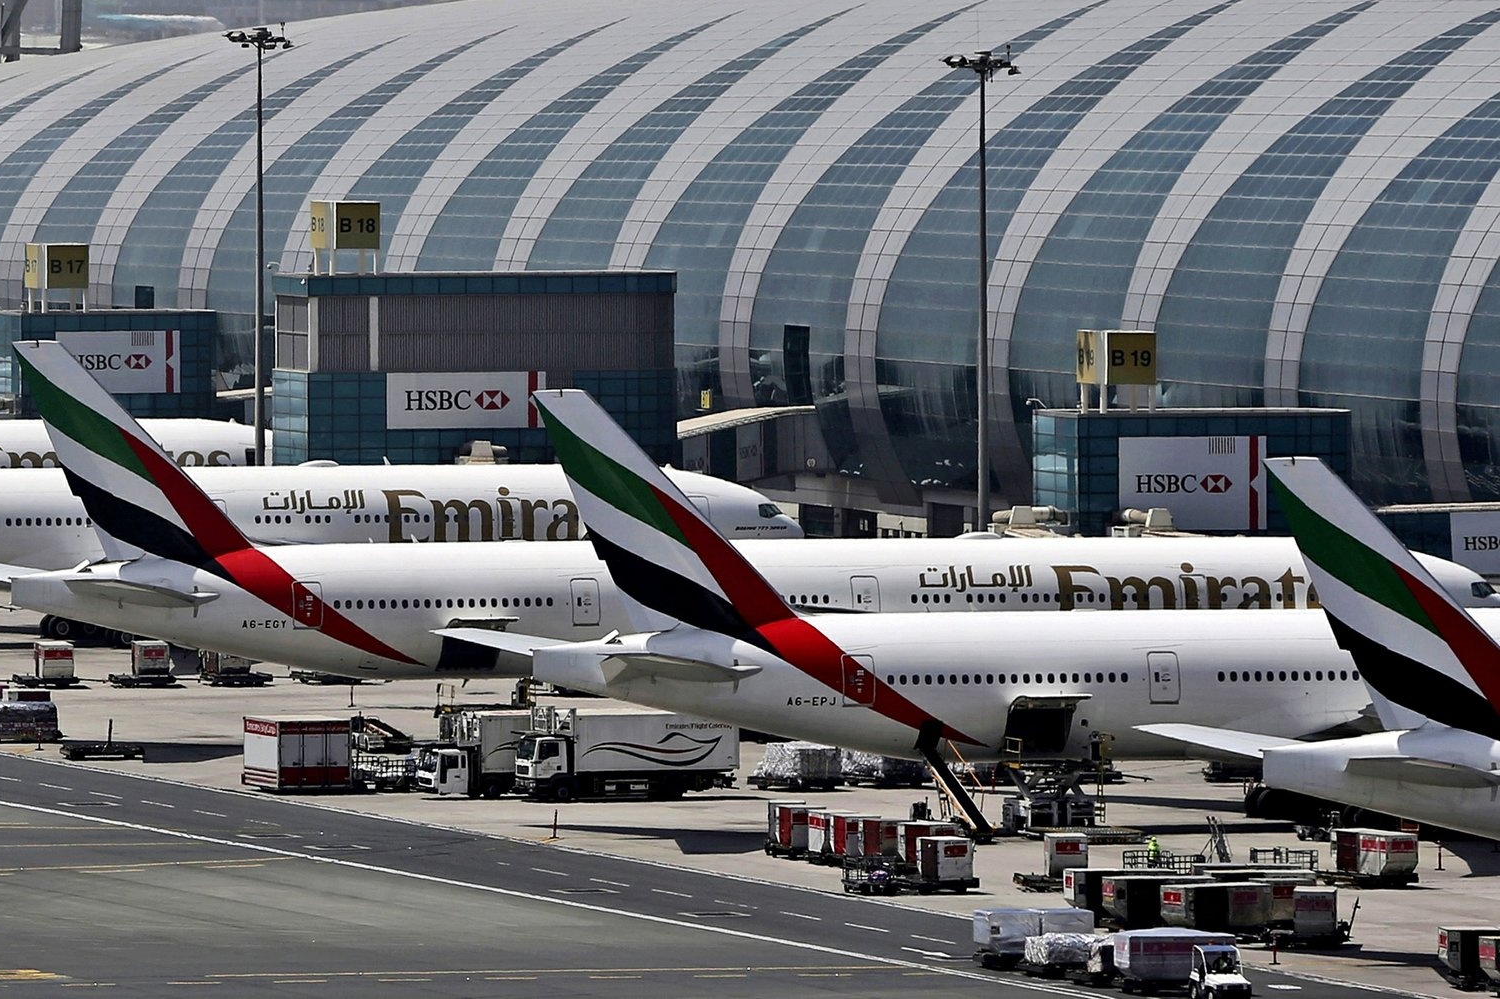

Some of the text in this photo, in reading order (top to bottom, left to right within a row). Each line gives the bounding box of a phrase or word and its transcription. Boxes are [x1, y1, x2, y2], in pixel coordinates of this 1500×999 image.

[340, 218, 376, 233] B 18
[51, 260, 84, 273] B 17
[1112, 350, 1151, 366] B 19
[405, 390, 471, 411] HSBC
[1135, 474, 1197, 493] HSBC
[263, 489, 365, 514] الإمارات
[381, 486, 583, 542] Emira
[1463, 535, 1500, 551] HSB
[919, 564, 1033, 593] الإمارات
[1051, 562, 1322, 610] Emirat
[242, 620, 287, 628] A6-EGY
[787, 697, 836, 706] A6-EPJ
